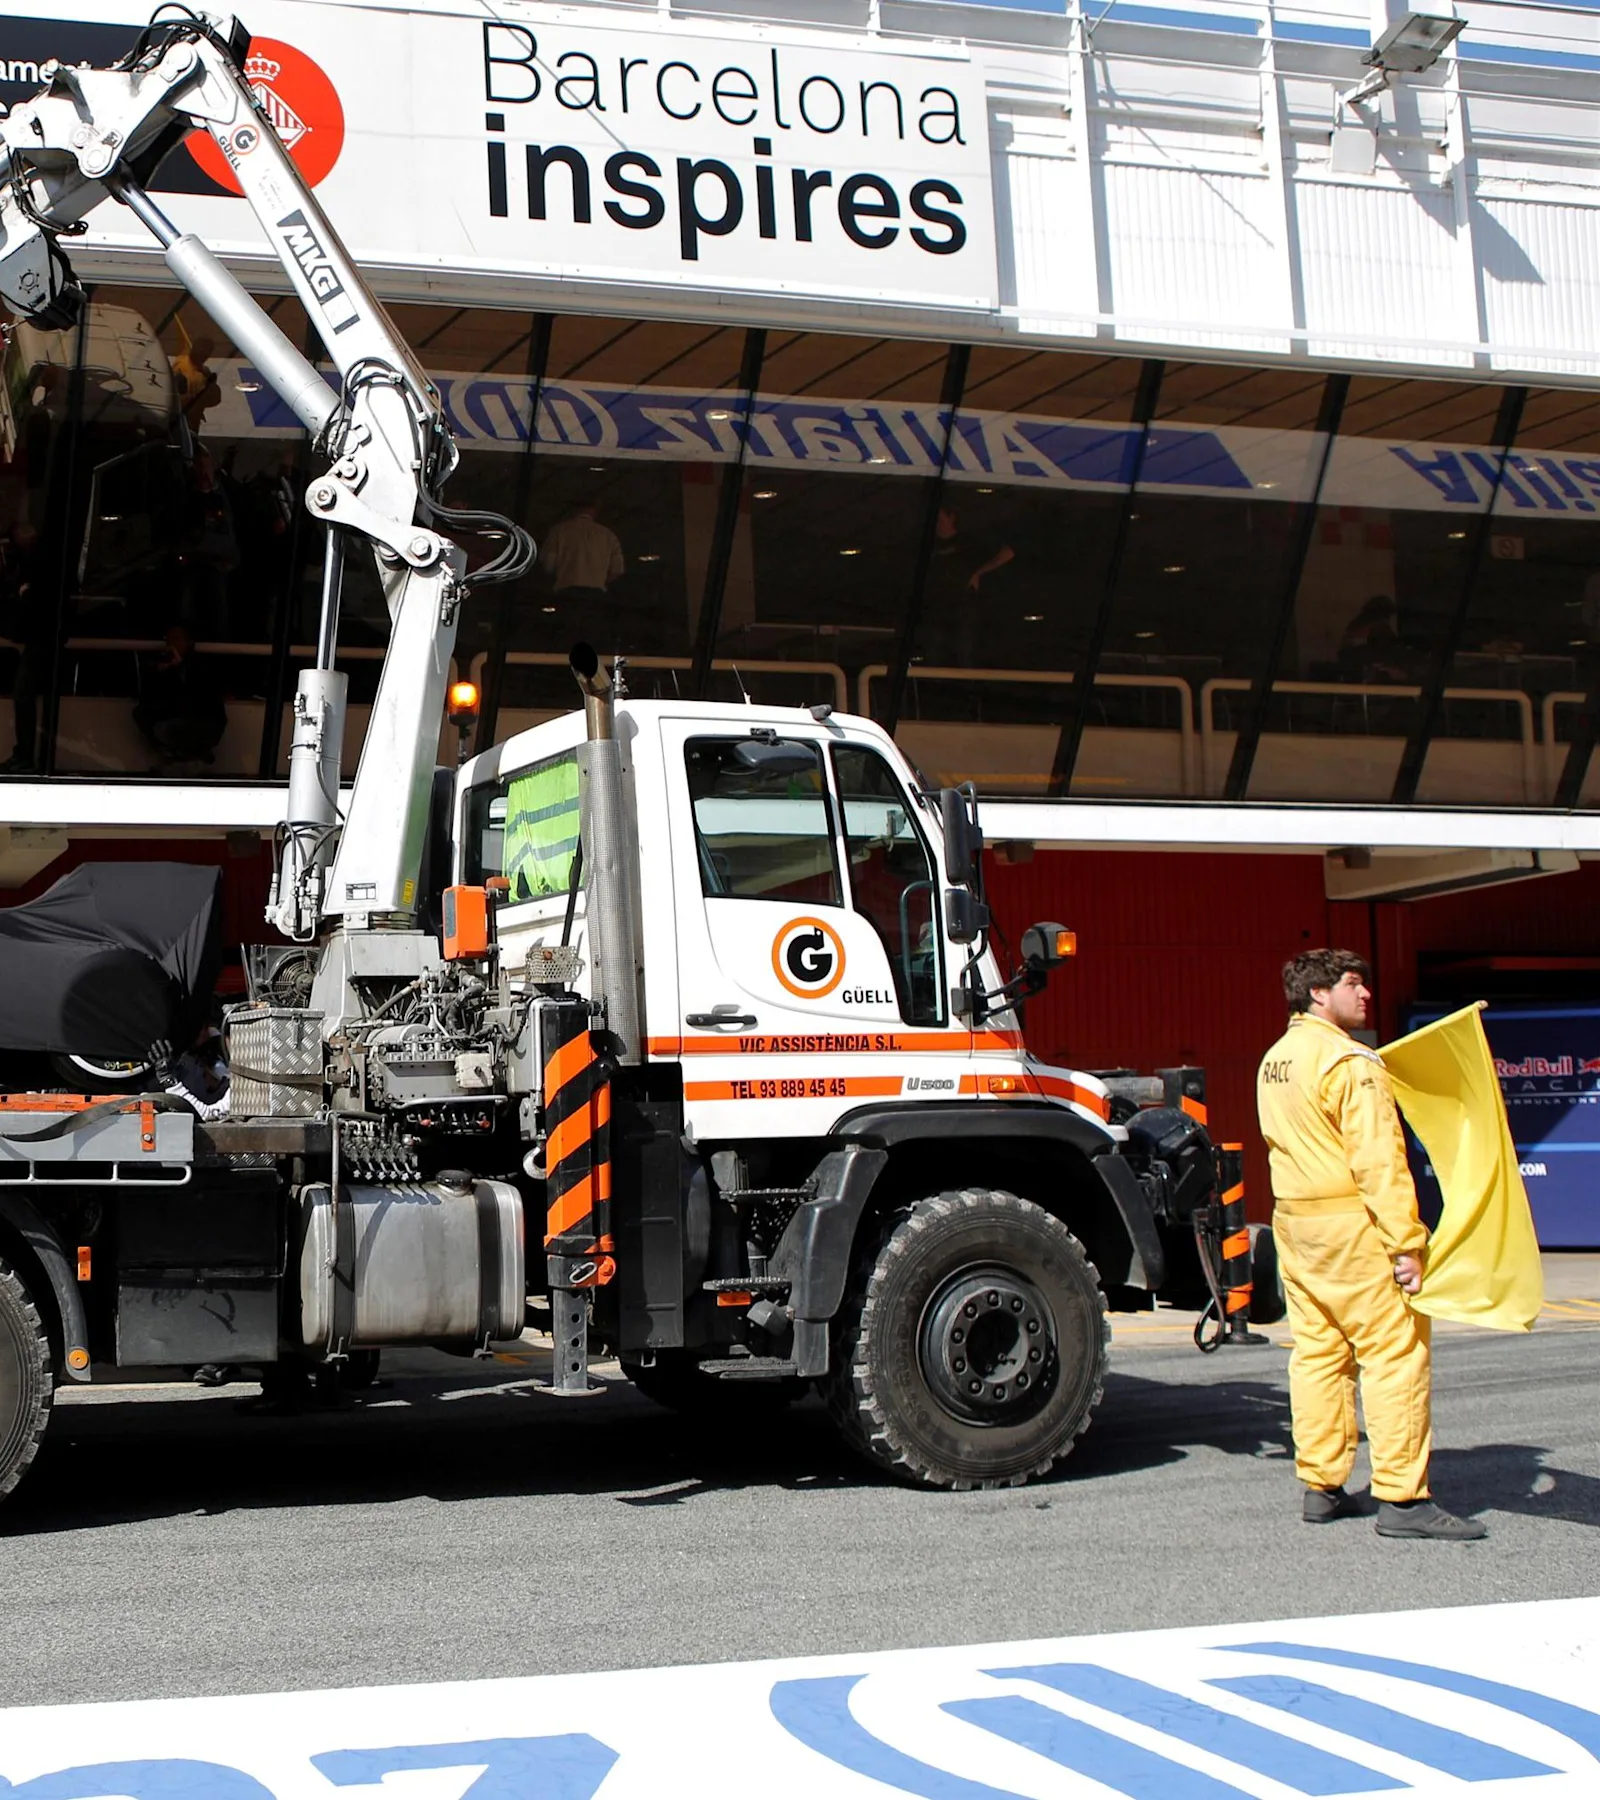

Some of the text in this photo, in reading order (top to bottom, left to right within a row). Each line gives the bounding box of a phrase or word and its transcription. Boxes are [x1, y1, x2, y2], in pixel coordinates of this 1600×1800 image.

[482, 21, 966, 146] Barcelona
[218, 135, 241, 171] GÜELL
[485, 112, 968, 260] inspires
[842, 986, 893, 1004] GÜELL
[739, 1033, 902, 1053] VIC ASSISTÈNCIA S.L.
[1263, 1060, 1292, 1084] RACC
[1496, 1055, 1573, 1077] Red Bull
[731, 1078, 846, 1099] TEL 93 889 45 45
